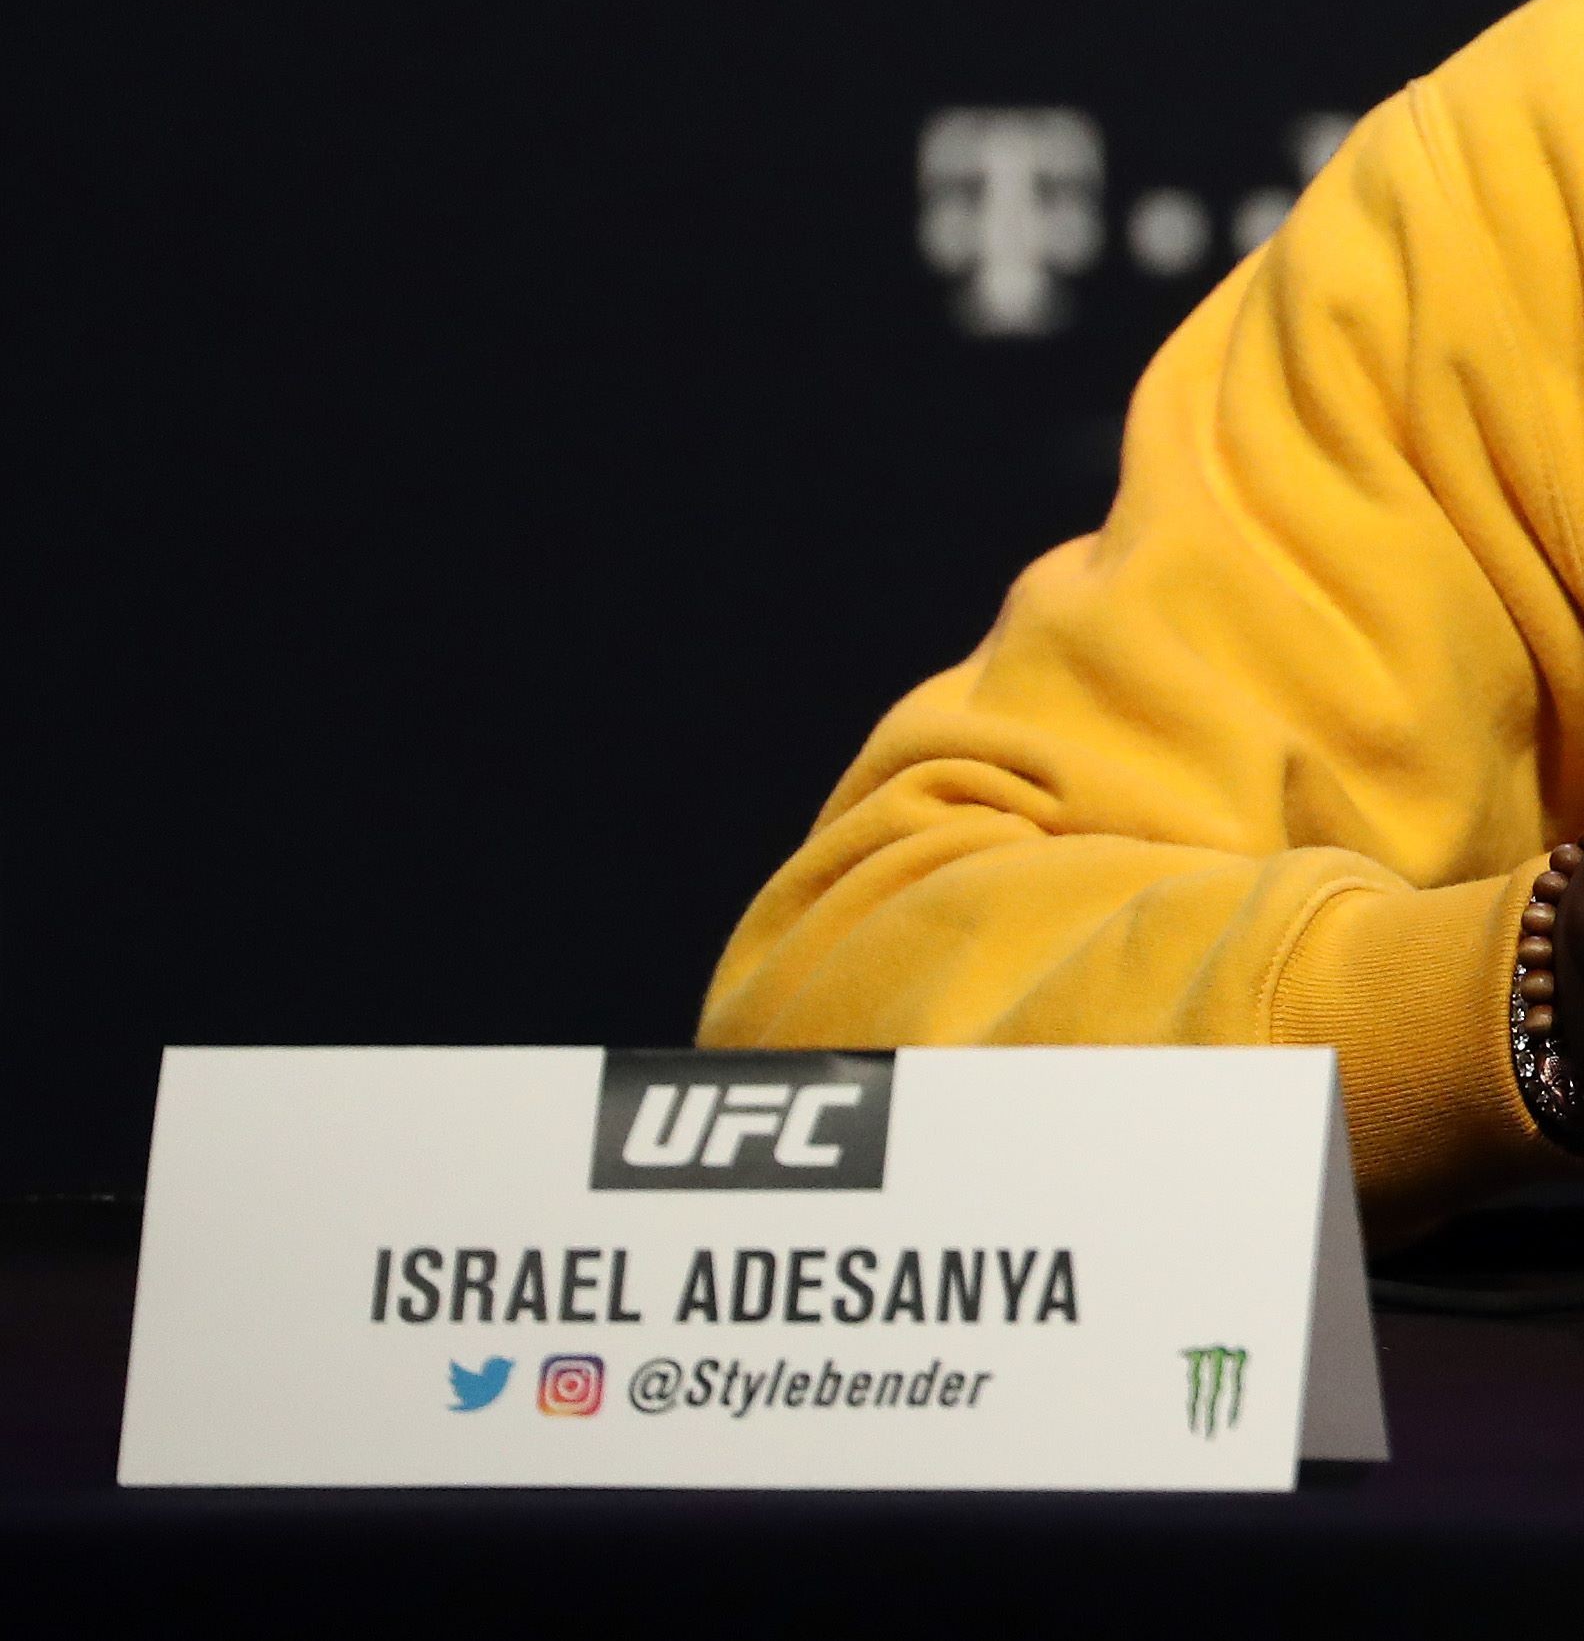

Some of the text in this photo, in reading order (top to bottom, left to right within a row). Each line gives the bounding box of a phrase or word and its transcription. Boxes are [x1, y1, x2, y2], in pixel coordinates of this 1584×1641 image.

[619, 1078, 864, 1169] UFC
[370, 1246, 1081, 1325] ISRAEL ADESANYA
[627, 1357, 993, 1419] @Stylebender
